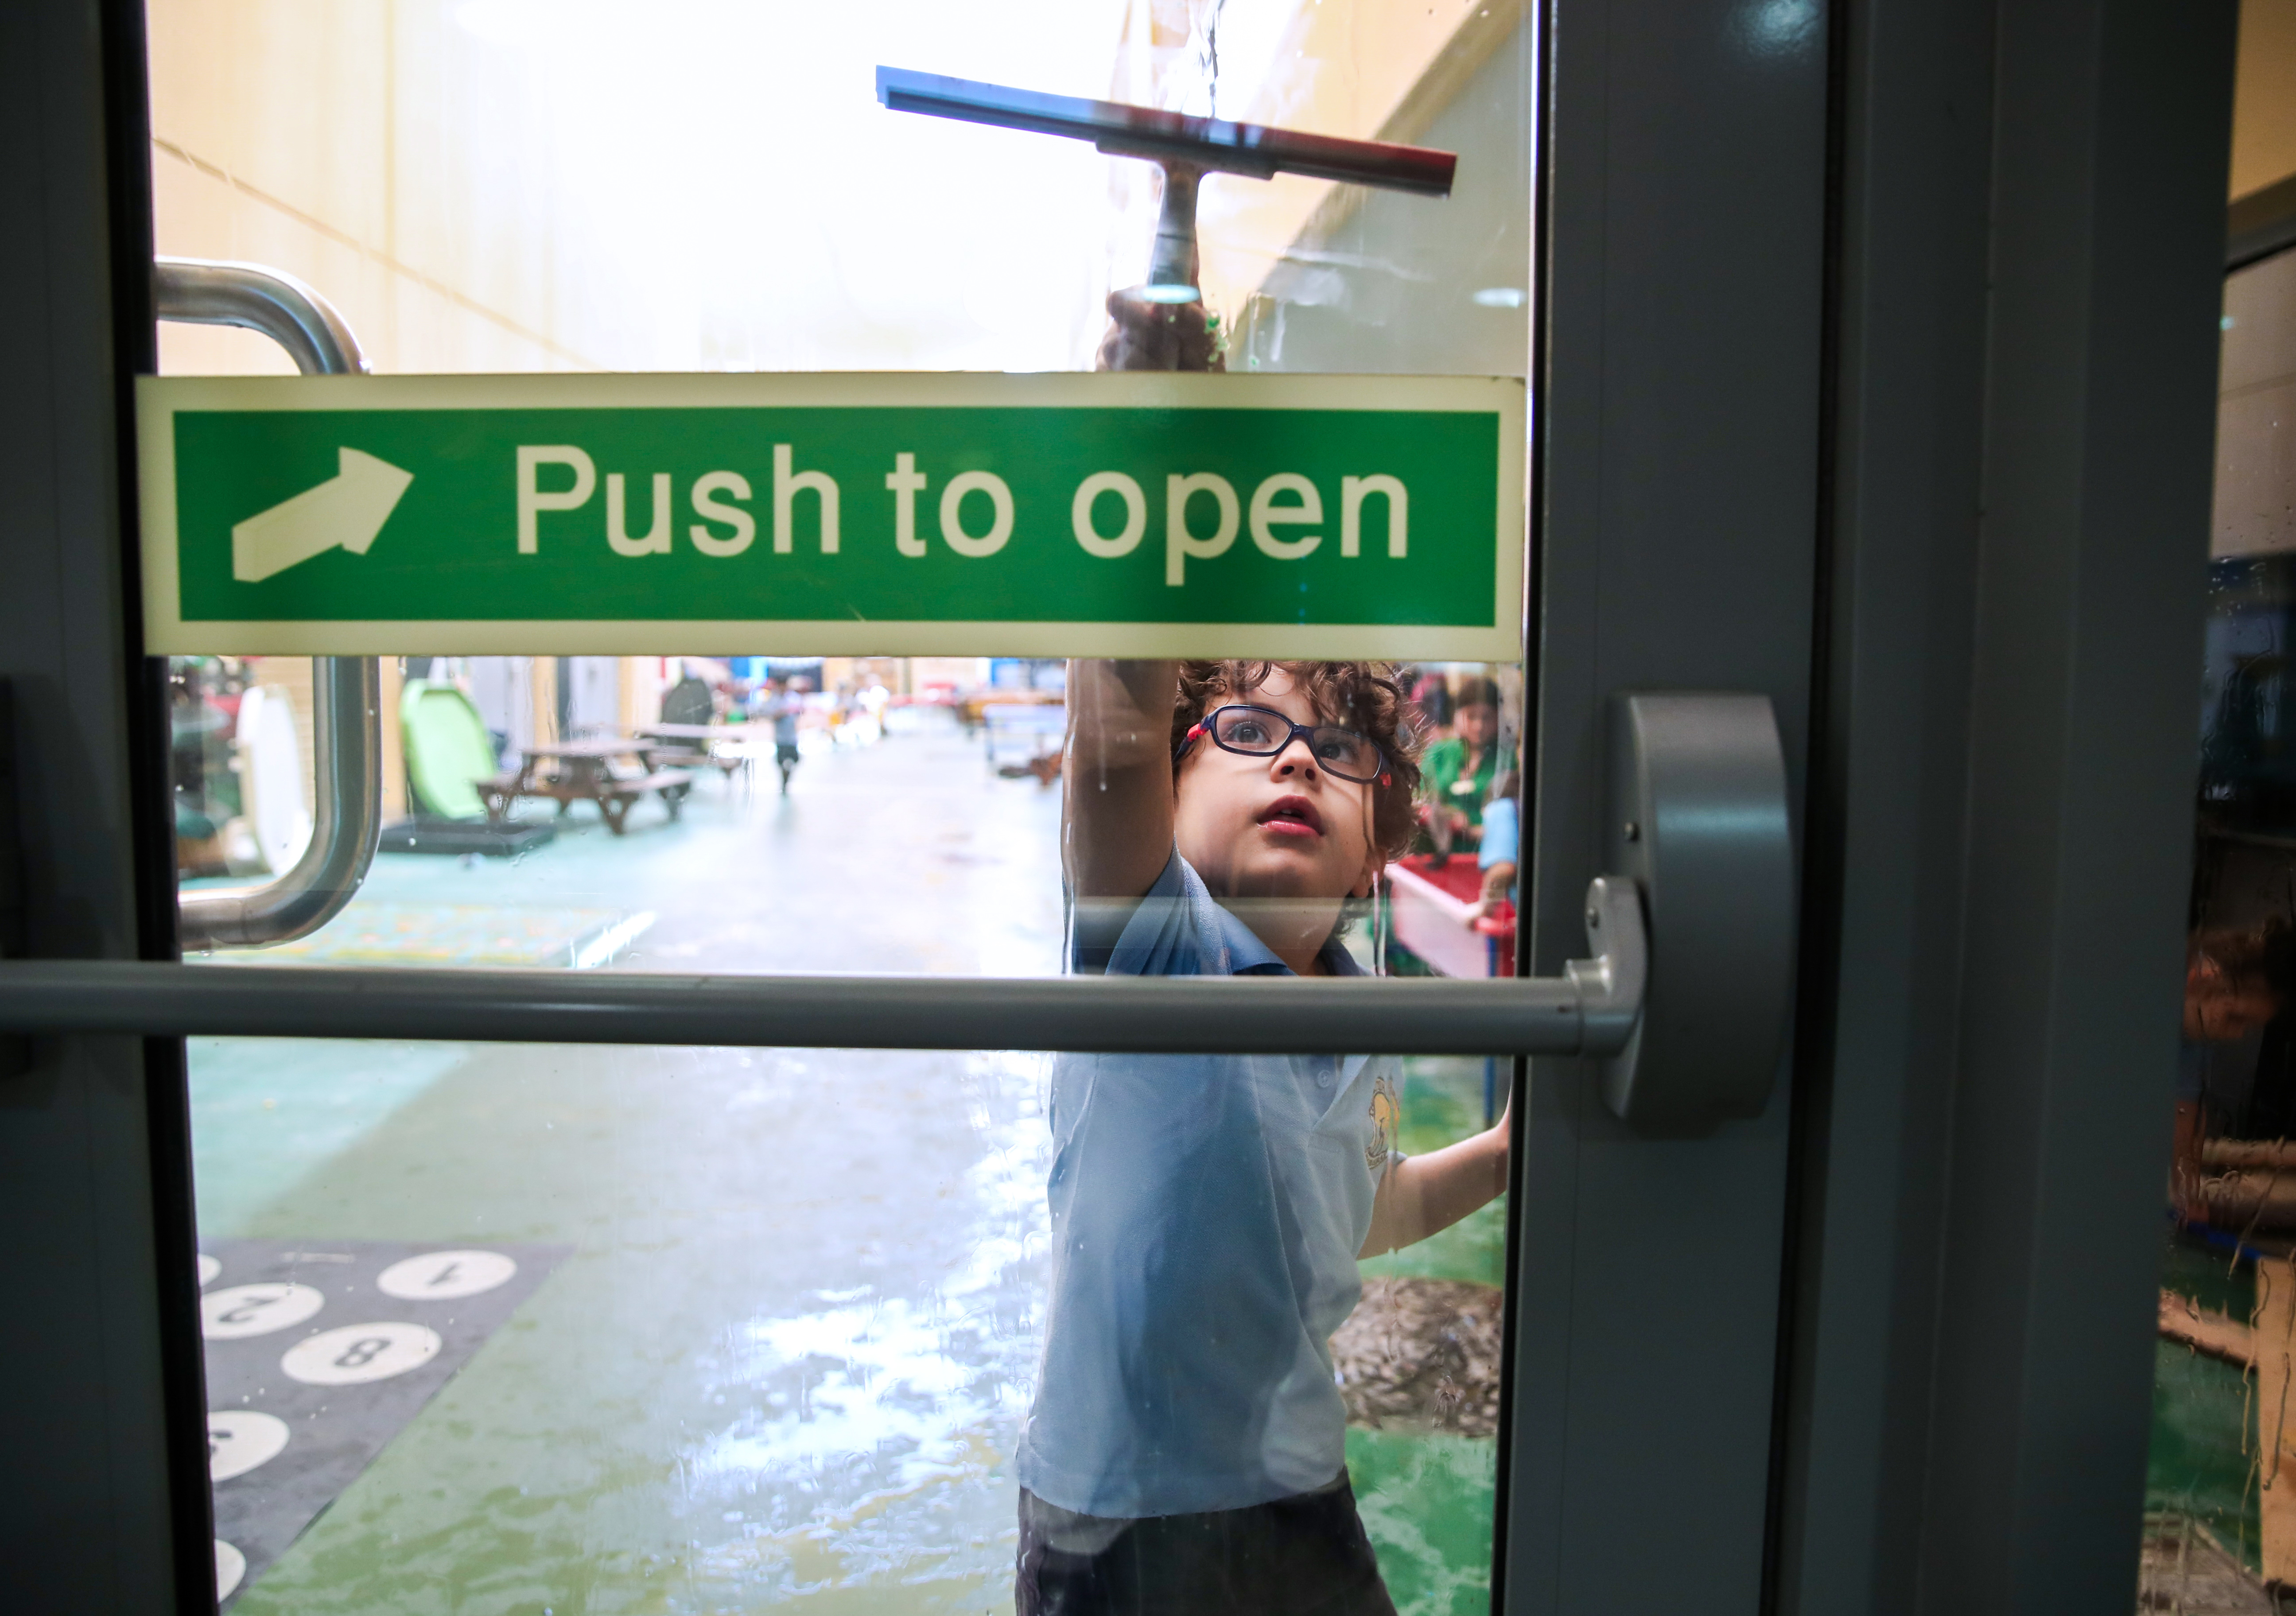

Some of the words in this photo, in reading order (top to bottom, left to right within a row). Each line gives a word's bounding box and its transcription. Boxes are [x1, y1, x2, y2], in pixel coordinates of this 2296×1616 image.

[516, 444, 840, 557] Push
[885, 452, 1014, 558] to
[1071, 471, 1409, 586] open
[218, 1296, 284, 1322] 2
[333, 1337, 393, 1367] 8
